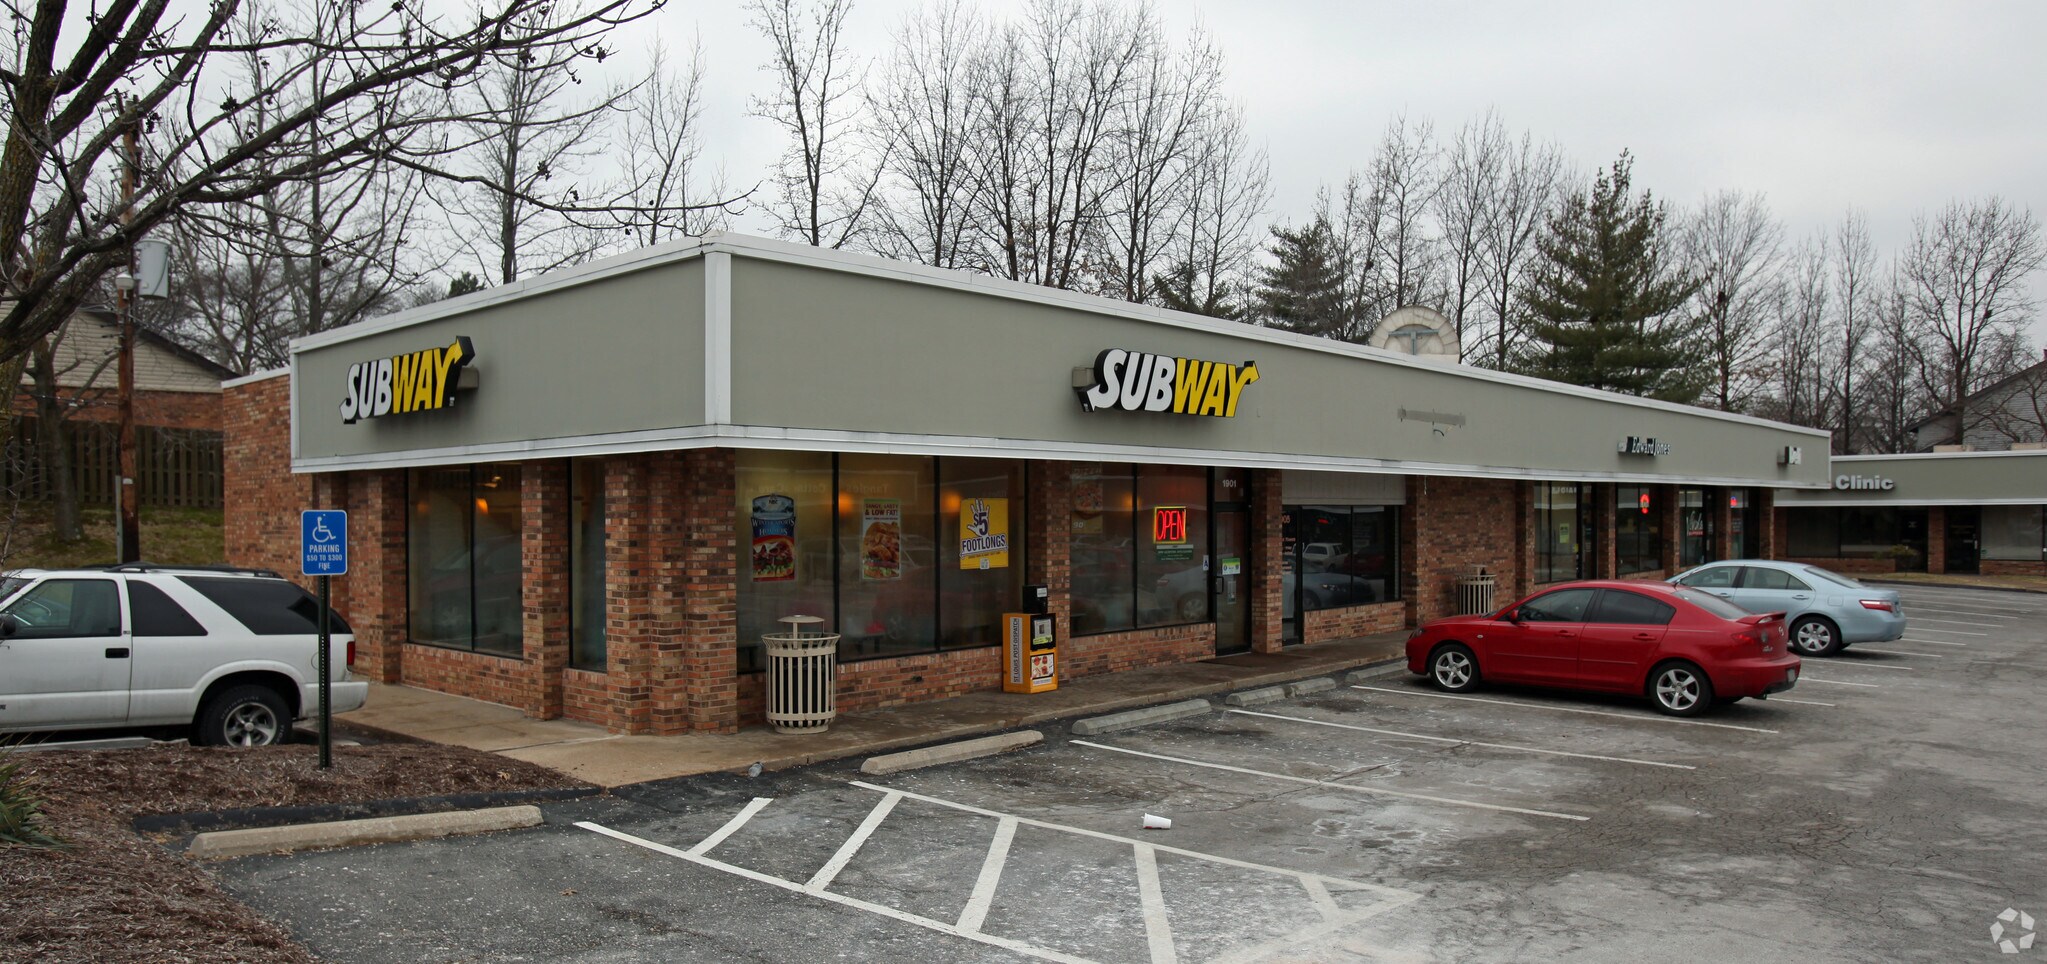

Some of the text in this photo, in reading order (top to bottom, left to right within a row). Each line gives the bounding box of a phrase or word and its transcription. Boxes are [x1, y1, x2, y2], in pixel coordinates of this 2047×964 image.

[340, 338, 463, 420] SUBWAY
[1087, 349, 1260, 418] SUBWAY
[1222, 479, 1237, 488] 1901
[1835, 474, 1894, 490] Clinic
[973, 512, 988, 535] $5
[1156, 510, 1185, 540] OPEN
[309, 544, 340, 553] PARKING
[962, 534, 1006, 552] FOOTLONGS
